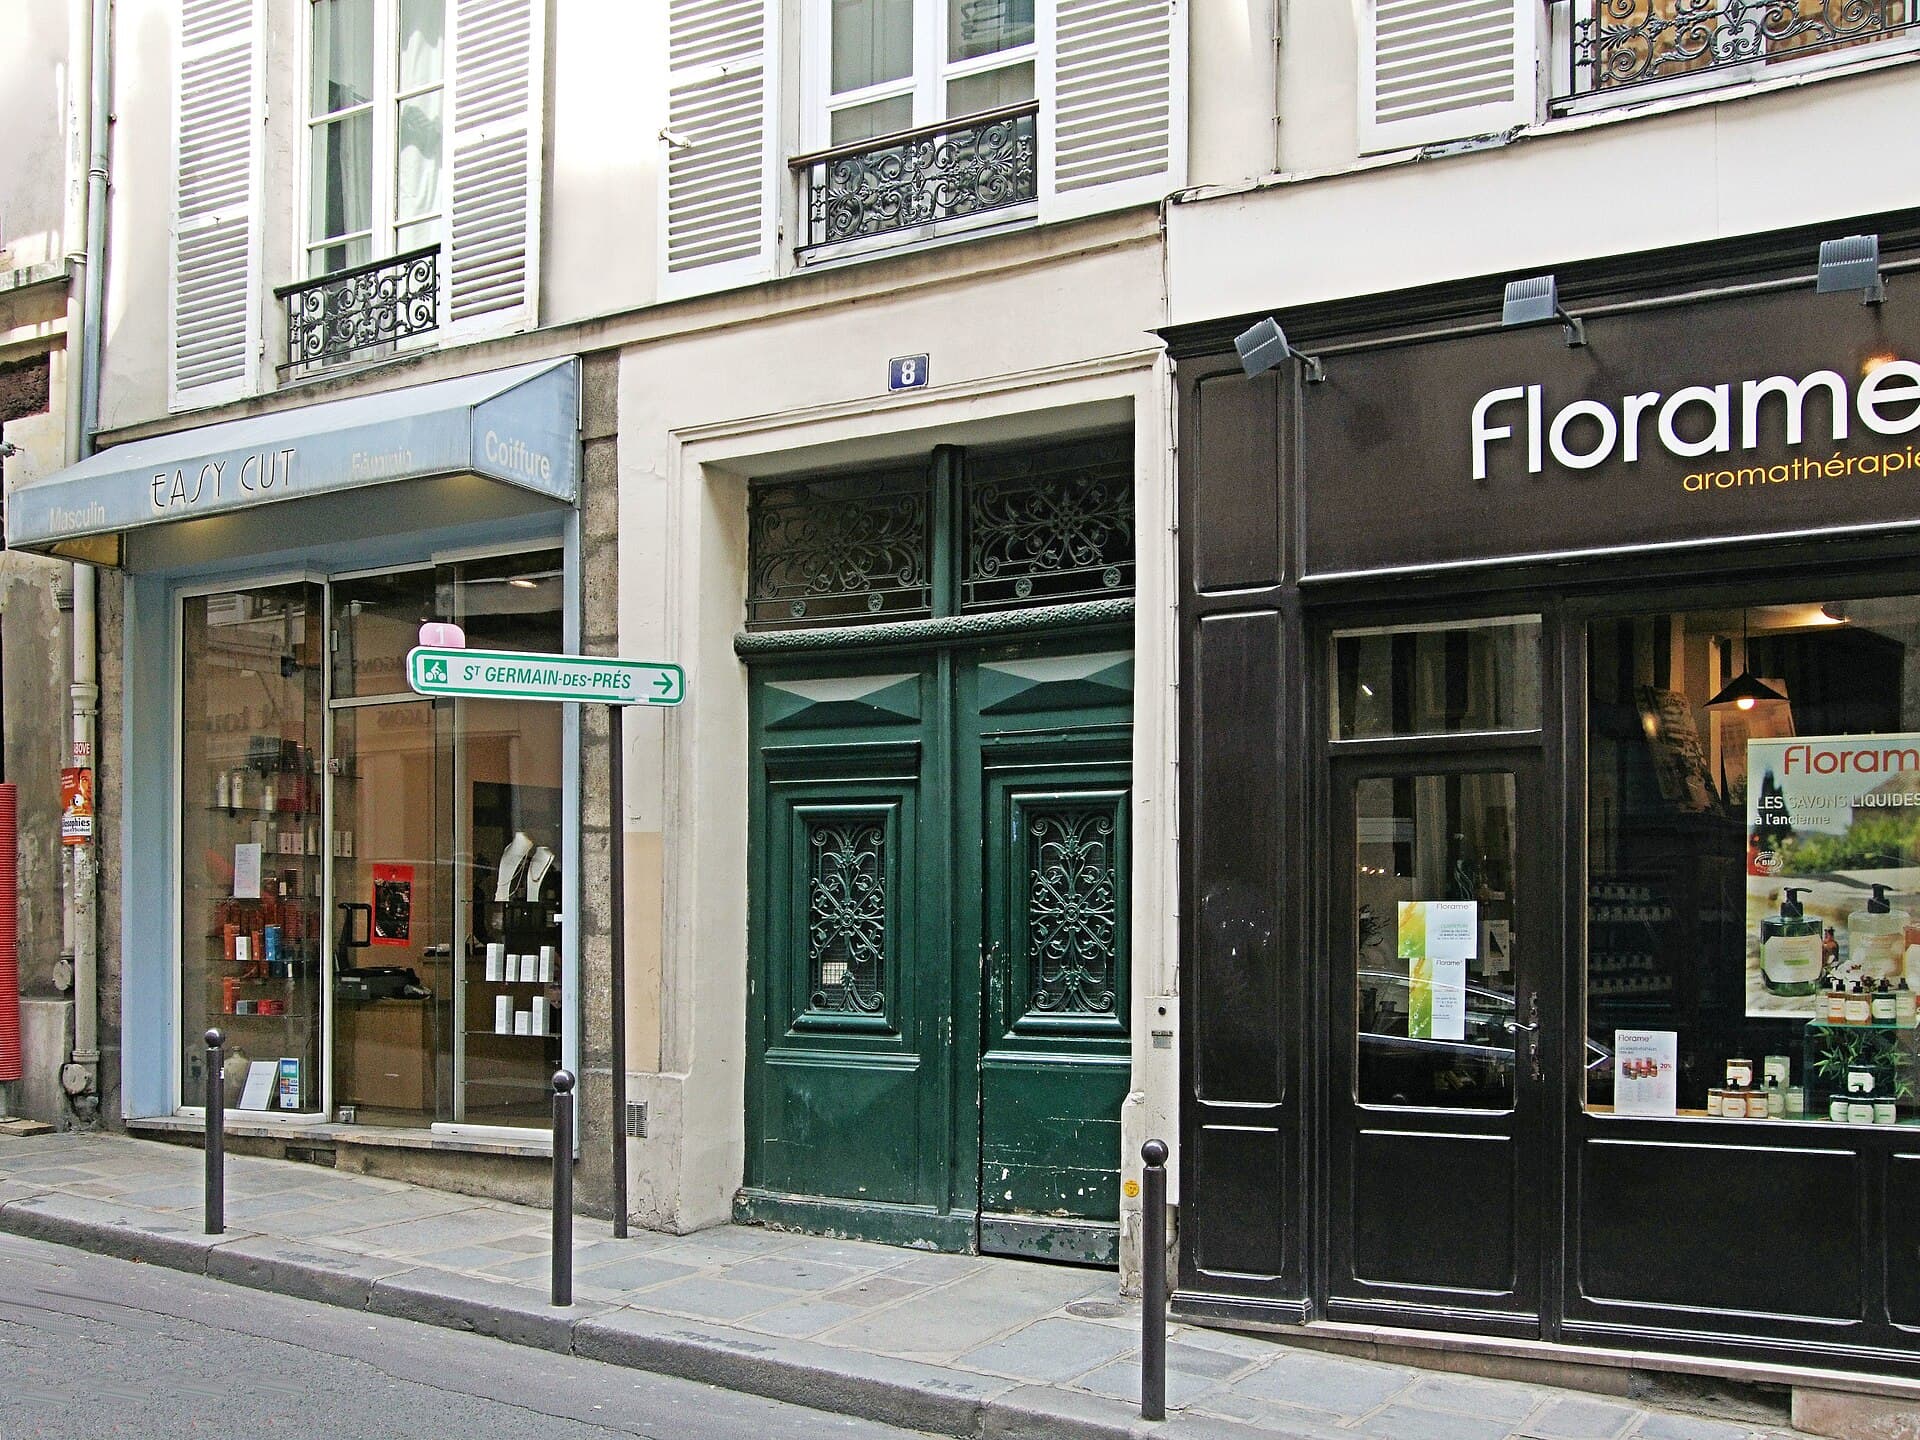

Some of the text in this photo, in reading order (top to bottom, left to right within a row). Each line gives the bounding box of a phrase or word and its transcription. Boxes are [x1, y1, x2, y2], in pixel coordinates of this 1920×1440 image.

[901, 359, 916, 385] 8
[1471, 359, 1920, 480] Florame
[485, 430, 551, 480] Coiffure
[151, 448, 295, 508] EASY CUT
[50, 503, 105, 532] Masculin
[434, 626, 445, 645] 1
[1756, 792, 1920, 809] LES SAVONS LIQUIDES
